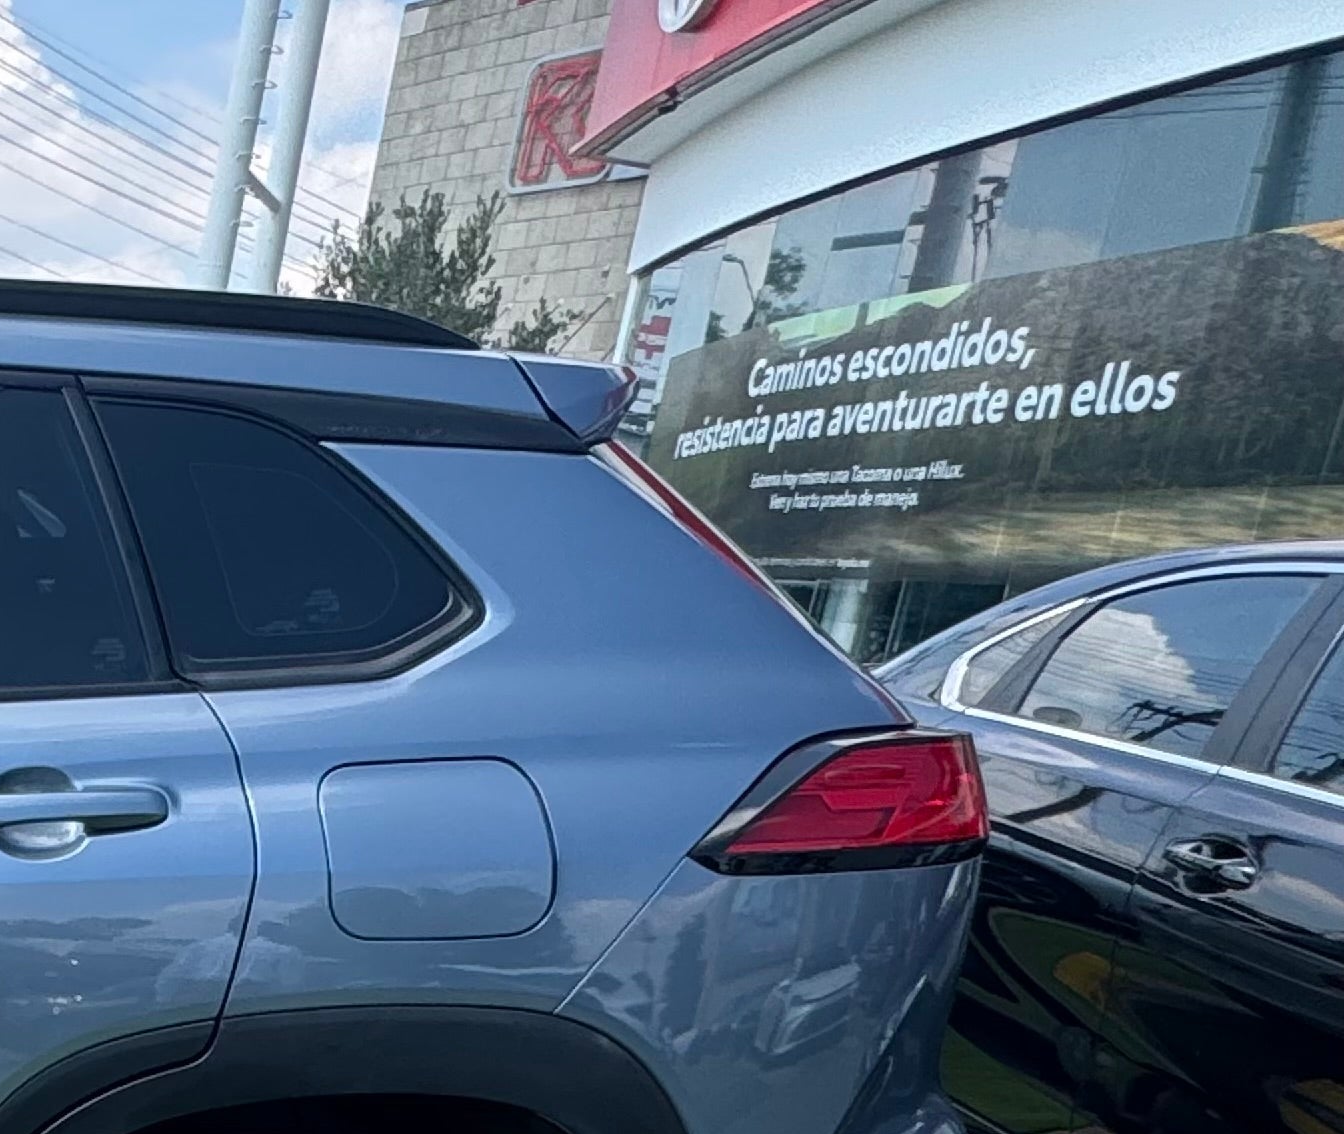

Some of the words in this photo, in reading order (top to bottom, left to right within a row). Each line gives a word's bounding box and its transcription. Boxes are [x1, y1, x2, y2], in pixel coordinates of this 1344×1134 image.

[748, 349, 845, 397] Caminos
[847, 317, 1036, 380] escondidos,
[673, 404, 771, 459] resistencia
[768, 408, 826, 453] para
[827, 381, 1009, 436] aventurarte
[1014, 384, 1064, 421] en
[1071, 360, 1182, 418] ellos
